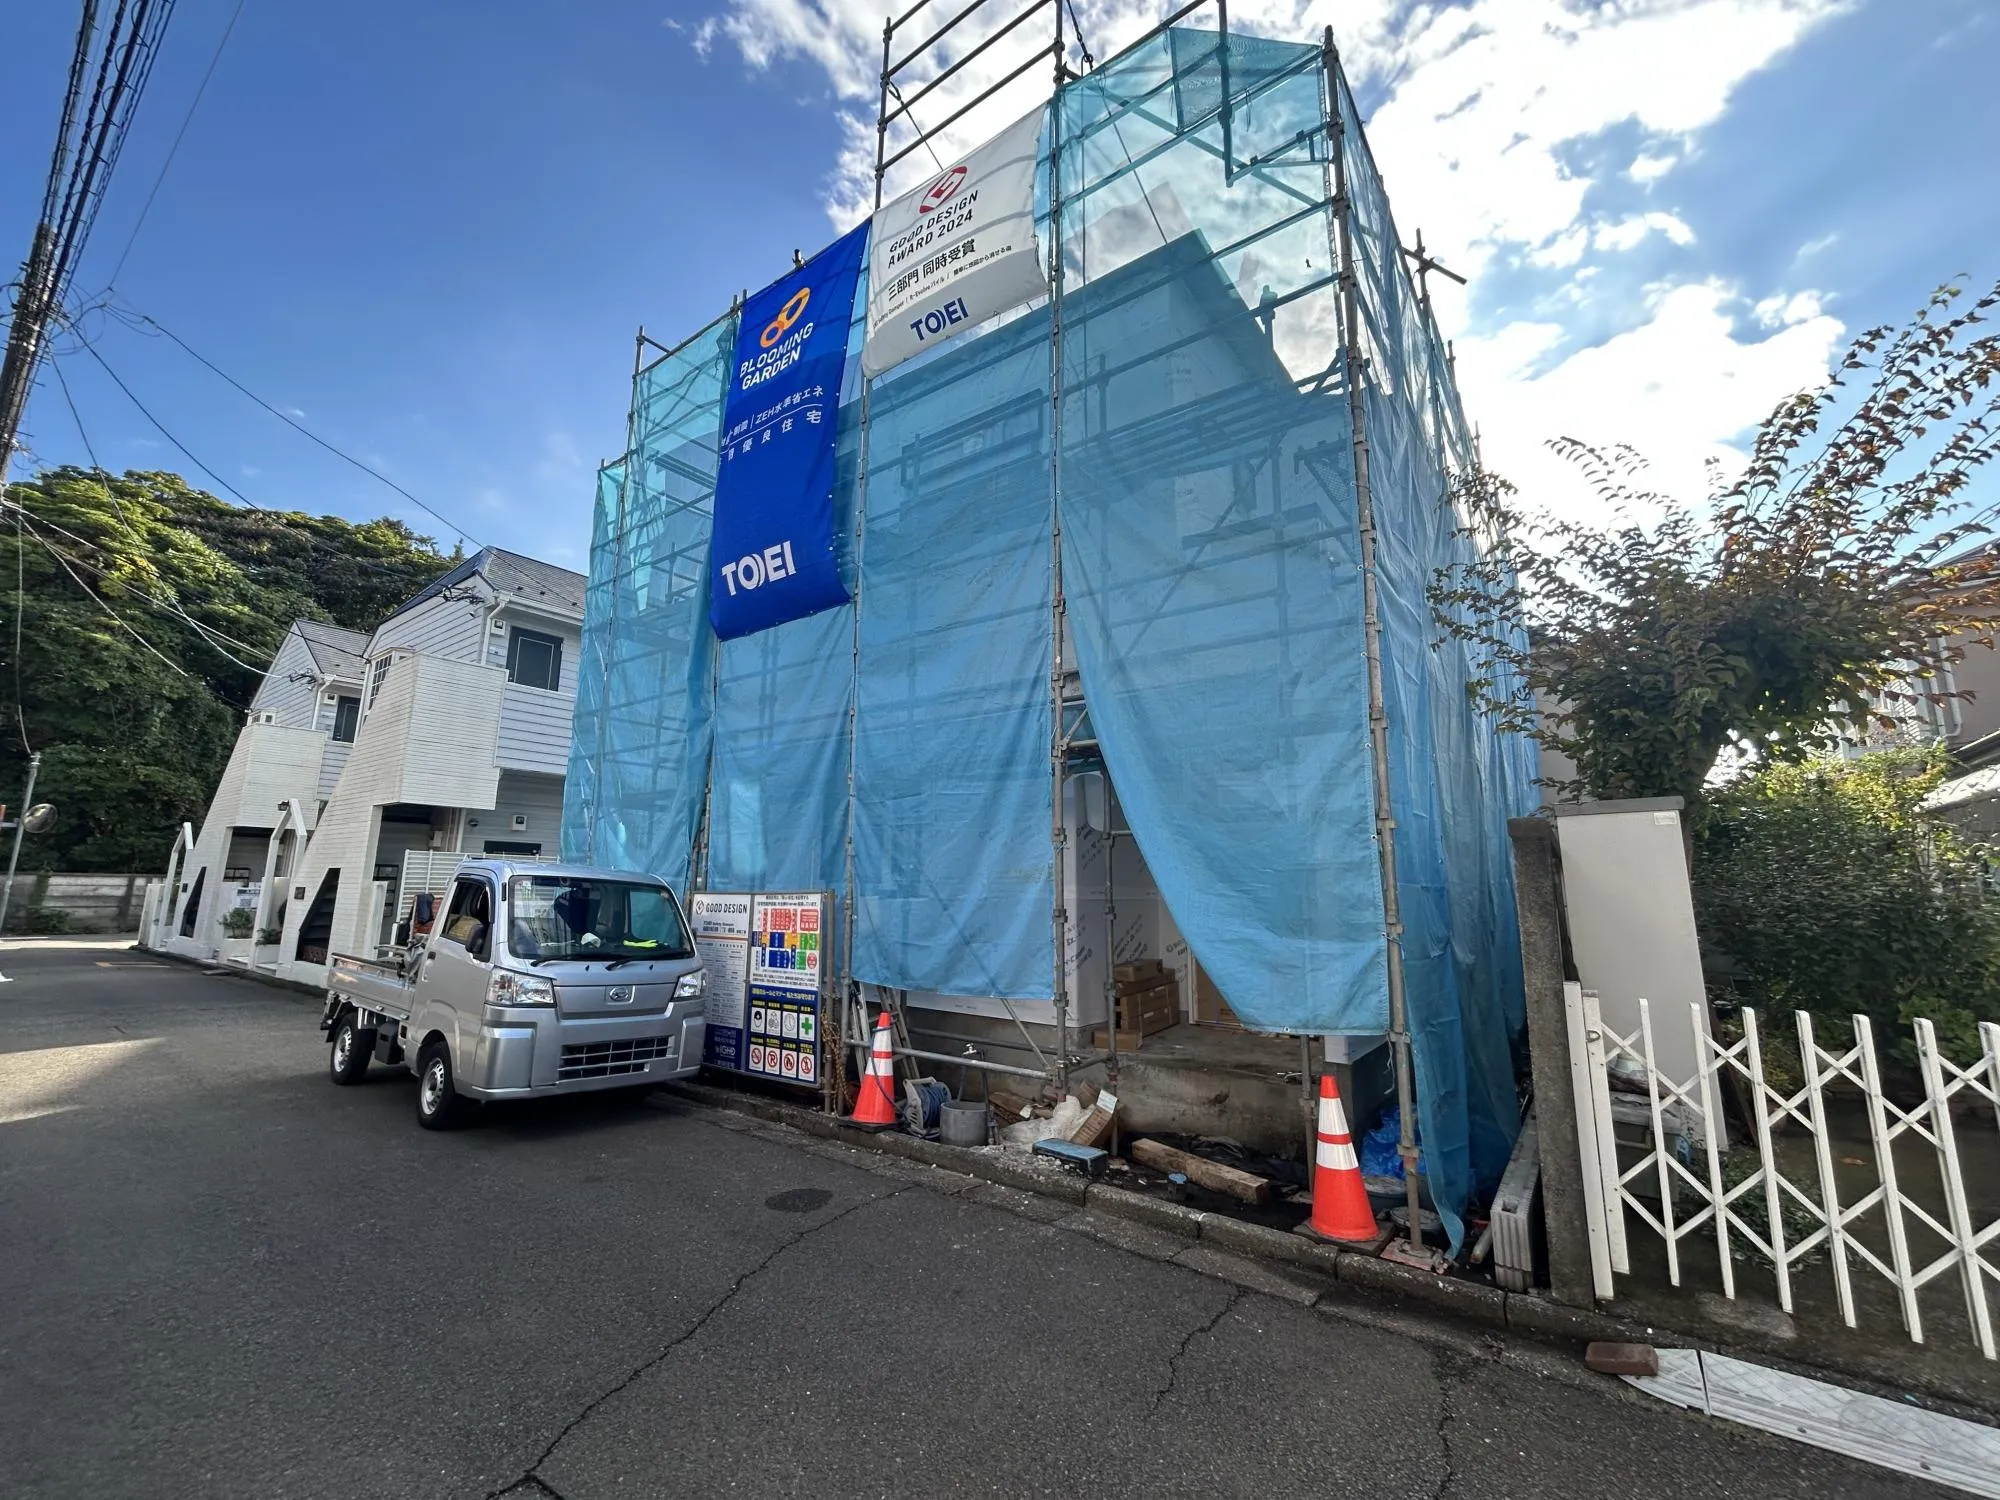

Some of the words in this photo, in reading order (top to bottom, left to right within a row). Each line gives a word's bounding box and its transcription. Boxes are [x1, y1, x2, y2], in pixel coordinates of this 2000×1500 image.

[888, 233, 933, 269] AWARD
[938, 209, 973, 238] 2024
[889, 224, 923, 253] GOOD
[926, 190, 979, 229] DESIGN
[888, 270, 920, 301] 三部門
[923, 238, 976, 279] 同時受賞
[910, 297, 969, 341] TOEI
[739, 322, 814, 378] BLOOMING
[742, 346, 800, 390] GARDEN
[721, 540, 796, 597] TOEI
[705, 903, 723, 913] GOOD
[724, 903, 748, 914] DESIGN
